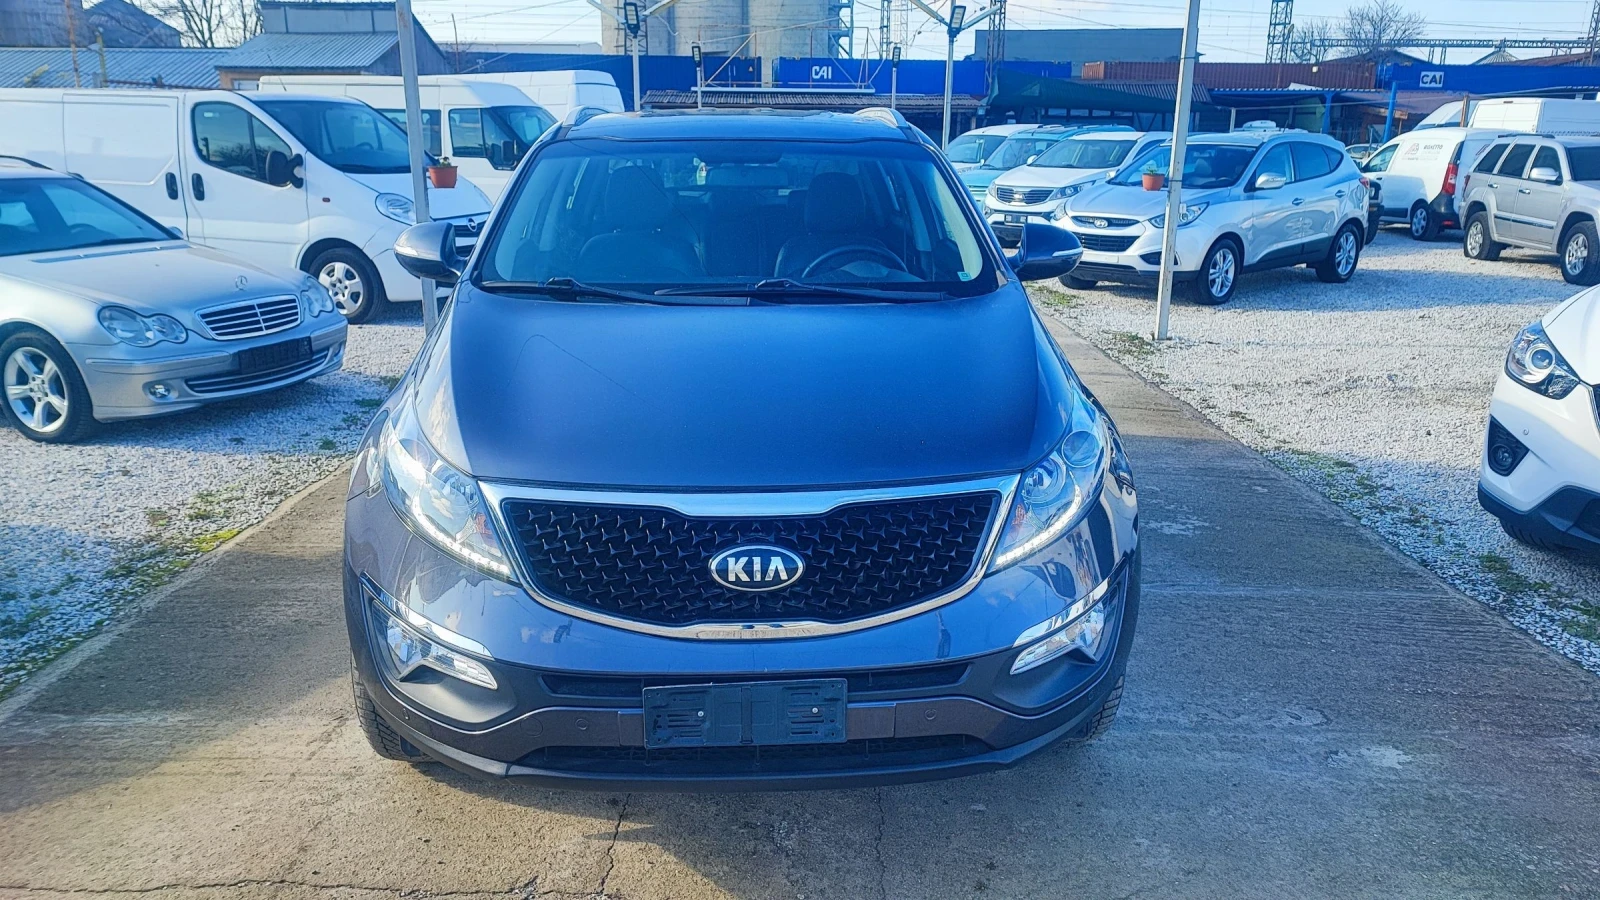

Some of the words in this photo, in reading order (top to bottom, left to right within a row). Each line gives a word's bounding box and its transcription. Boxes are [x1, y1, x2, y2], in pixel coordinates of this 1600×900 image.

[812, 65, 832, 79] CAI
[1421, 74, 1443, 85] CAI
[726, 556, 789, 582] KIA
